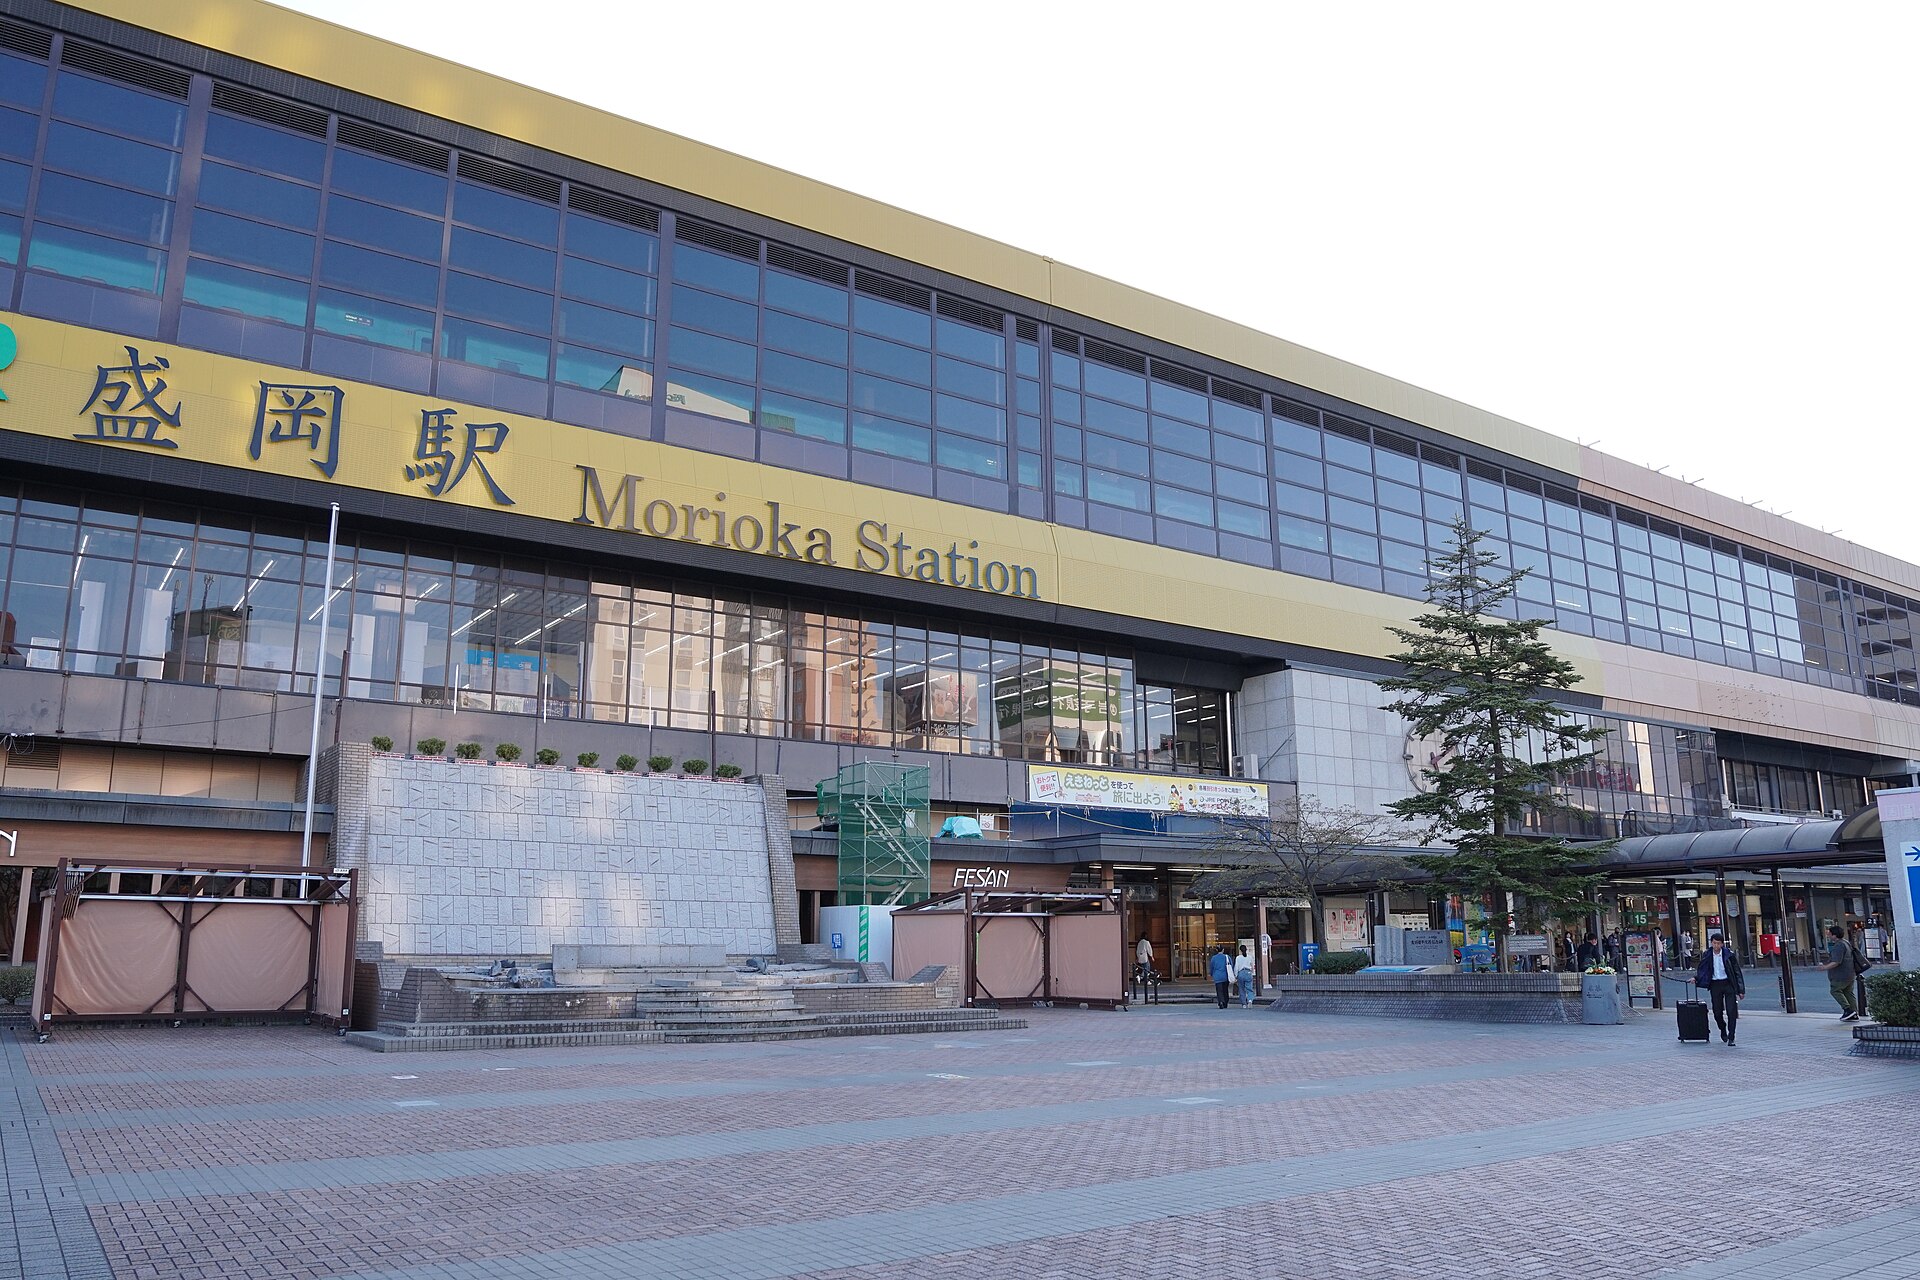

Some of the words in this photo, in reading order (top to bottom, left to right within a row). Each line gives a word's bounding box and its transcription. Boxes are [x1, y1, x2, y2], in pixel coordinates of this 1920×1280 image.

[73, 345, 515, 505] 盛岡駅
[574, 464, 837, 566] Morioka
[857, 519, 1041, 600] Station
[1036, 775, 1056, 784] おトクで
[1064, 772, 1110, 791] えきねっと
[1110, 781, 1134, 790] を使って
[1634, 914, 1647, 925] 15
